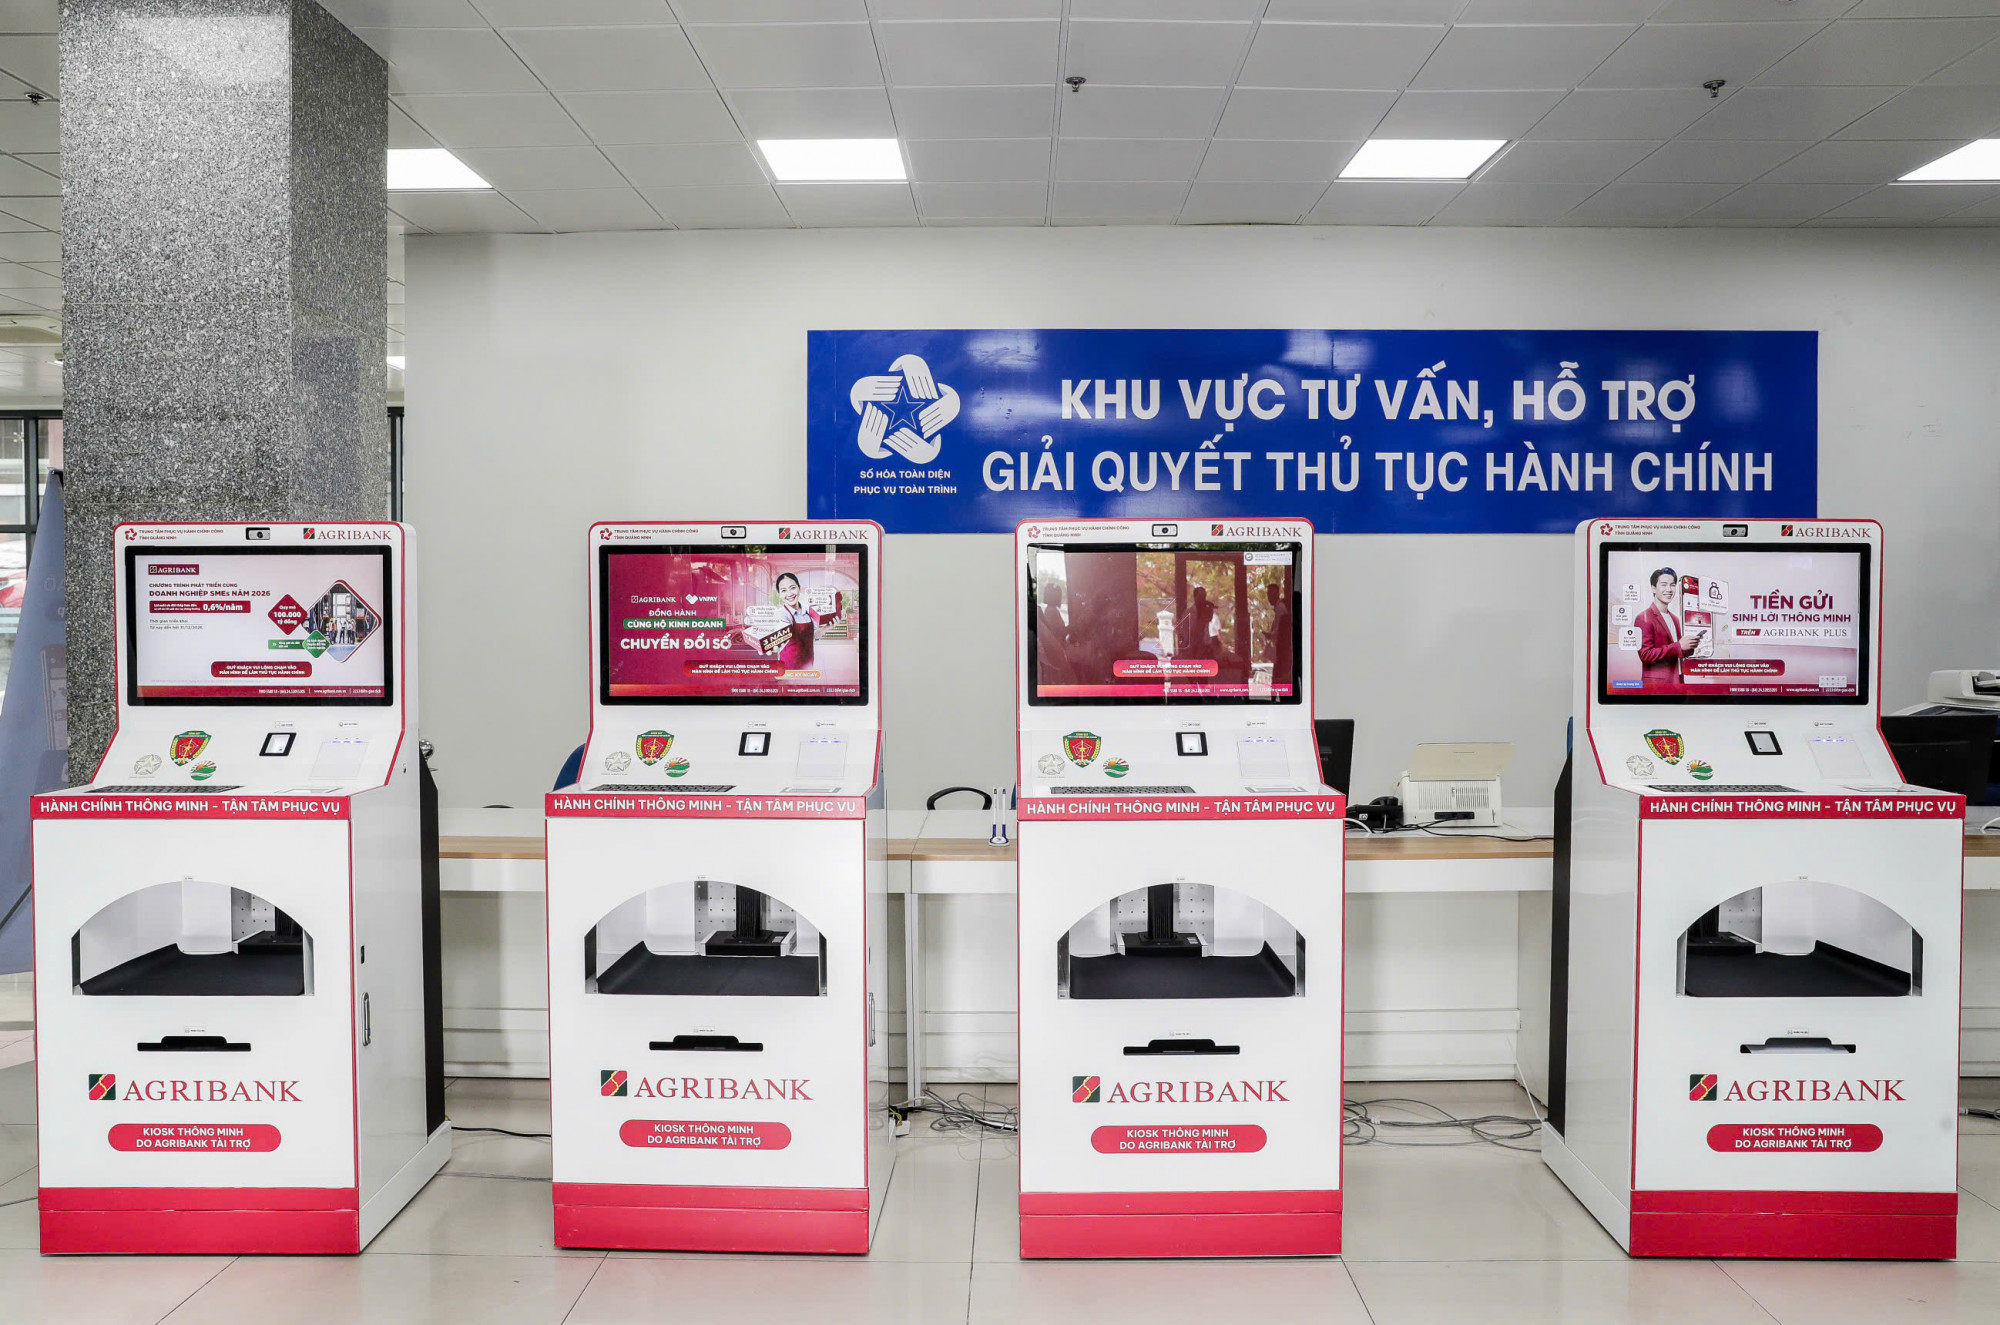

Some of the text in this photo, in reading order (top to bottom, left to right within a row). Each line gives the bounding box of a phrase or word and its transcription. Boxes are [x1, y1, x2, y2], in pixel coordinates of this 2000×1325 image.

[1062, 360, 1696, 433] KHU VỰC TƯ VẤN, HỖ TRỢ
[983, 434, 1773, 500] GIẢI QUYẾT THỦ TỤC HÀNH CHÍNH
[860, 468, 951, 480] SỐ HÓA TOÀN DIỆN
[853, 484, 957, 496] PHỤC VỤ TOÀN TRÌNH
[317, 529, 392, 541] AGRIBANK
[793, 529, 869, 540] AGRIBANK
[1226, 527, 1302, 538] AGRIBANK
[1795, 527, 1872, 538] AGRIBANK
[179, 589, 208, 598] NGHIỆP
[232, 588, 250, 597] NĂM
[1750, 588, 1794, 609] TIỀN
[1799, 589, 1834, 610] GỬI
[202, 603, 243, 612] 0,6%/năm
[649, 607, 697, 616] ĐỒNG HÀNH
[1732, 611, 1851, 622] SINH LỜI THÔNG MINH
[627, 619, 651, 628] CÙNG
[653, 619, 667, 629] HỘ
[1763, 629, 1819, 637] AGRIBANK
[1824, 629, 1848, 637] PLUS
[620, 632, 680, 649] CHUYỂN
[683, 632, 710, 649] ĐỔI
[712, 633, 732, 649] SỐ
[41, 798, 78, 812] HÀNH
[81, 798, 122, 812] CHÍNH
[125, 798, 172, 812] THÔNG
[175, 800, 209, 812] MINH
[222, 798, 248, 815] TẬN
[251, 798, 279, 812] TÂM
[282, 801, 318, 815] PHỤC
[321, 801, 340, 815] VỤ
[554, 797, 591, 810] HÀNH
[594, 797, 635, 810] CHÍNH
[638, 797, 687, 811] THÔNG
[689, 800, 722, 811] MINH
[736, 798, 763, 815] TẬN
[765, 798, 795, 812] TÂM
[797, 801, 835, 815] PHỤC
[837, 801, 857, 815] VỤ
[1027, 799, 1066, 814] HÀNH
[1069, 799, 1111, 814] CHÍNH
[1114, 799, 1163, 813] THÔNG
[1166, 801, 1200, 813] MINH
[1214, 798, 1241, 816] TẬN
[1244, 798, 1273, 813] TÂM
[1276, 801, 1314, 816] PHỤC
[1316, 801, 1336, 815] VỤ
[1650, 799, 1689, 813] HÀNH
[1691, 798, 1733, 812] CHÍNH
[1736, 798, 1784, 812] THÔNG
[1787, 801, 1821, 812] MINH
[1835, 798, 1862, 815] TẬN
[1865, 798, 1893, 812] TÂM
[1896, 801, 1934, 815] PHỤC
[1937, 801, 1956, 815] VỤ
[123, 1080, 303, 1101] AGRIBANK
[634, 1077, 814, 1100] AGRIBANK
[1107, 1080, 1290, 1103] AGRIBANK
[1724, 1079, 1907, 1101] AGRIBANK
[143, 1125, 244, 1136] KIOSK THÔNG MINH
[654, 1122, 754, 1134] KIOSK THÔNG MINH
[1127, 1127, 1230, 1138] KIOSK THÔNG MINH
[1743, 1125, 1845, 1136] KIOSK THÔNG MINH
[136, 1137, 251, 1150] DO AGRIBANK TÀI TRỢ
[647, 1134, 761, 1148] DO AGRIBANK TÀI TRỢ
[1119, 1139, 1237, 1152] DO AGRIBANK TÀI TRỢ
[1735, 1137, 1852, 1151] DO AGRIBANK TÀI TRỢ
